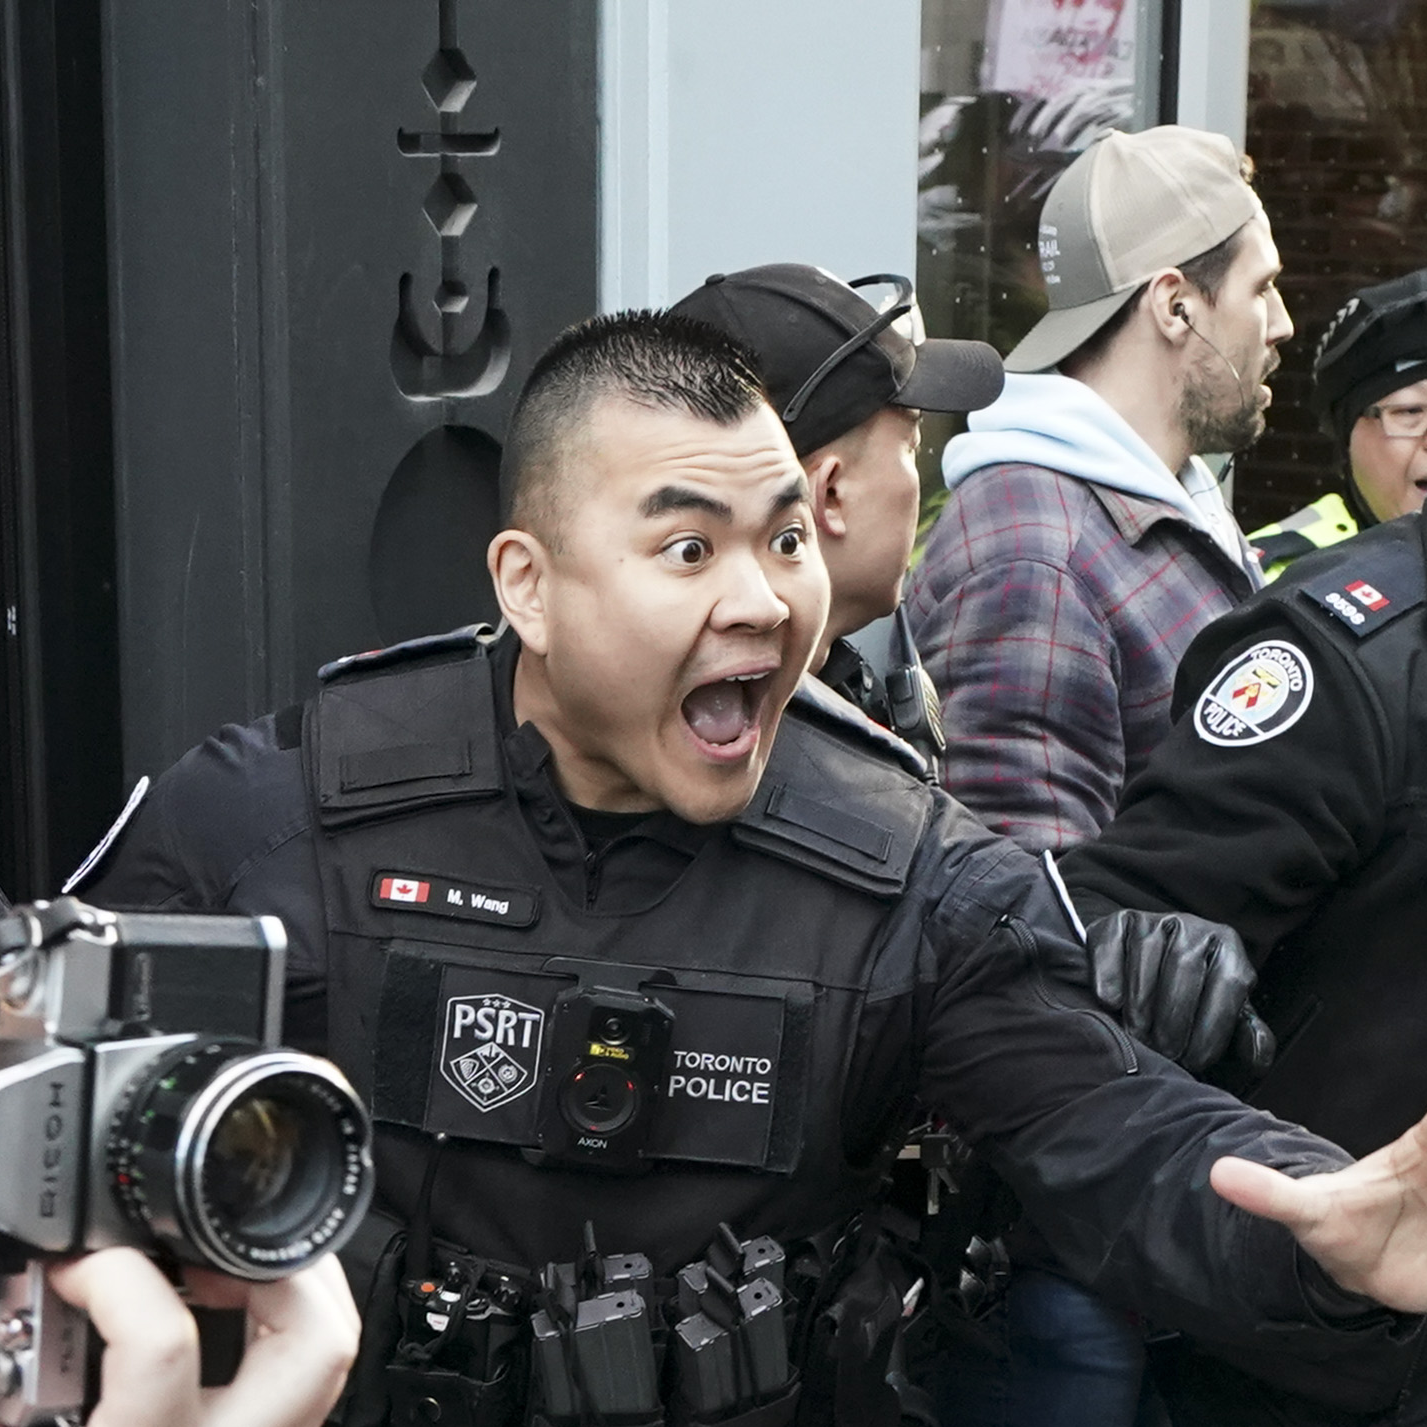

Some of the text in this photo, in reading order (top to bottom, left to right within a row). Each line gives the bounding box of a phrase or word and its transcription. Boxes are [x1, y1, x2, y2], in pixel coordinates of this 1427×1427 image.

[1250, 648, 1304, 692] TORONTO
[1203, 702, 1247, 738] POLICE
[446, 888, 510, 915] M. Wang
[453, 1003, 541, 1048] PSRT
[673, 1050, 772, 1075] TORONTO
[668, 1075, 771, 1104] POLICE
[576, 1136, 608, 1150] AXON
